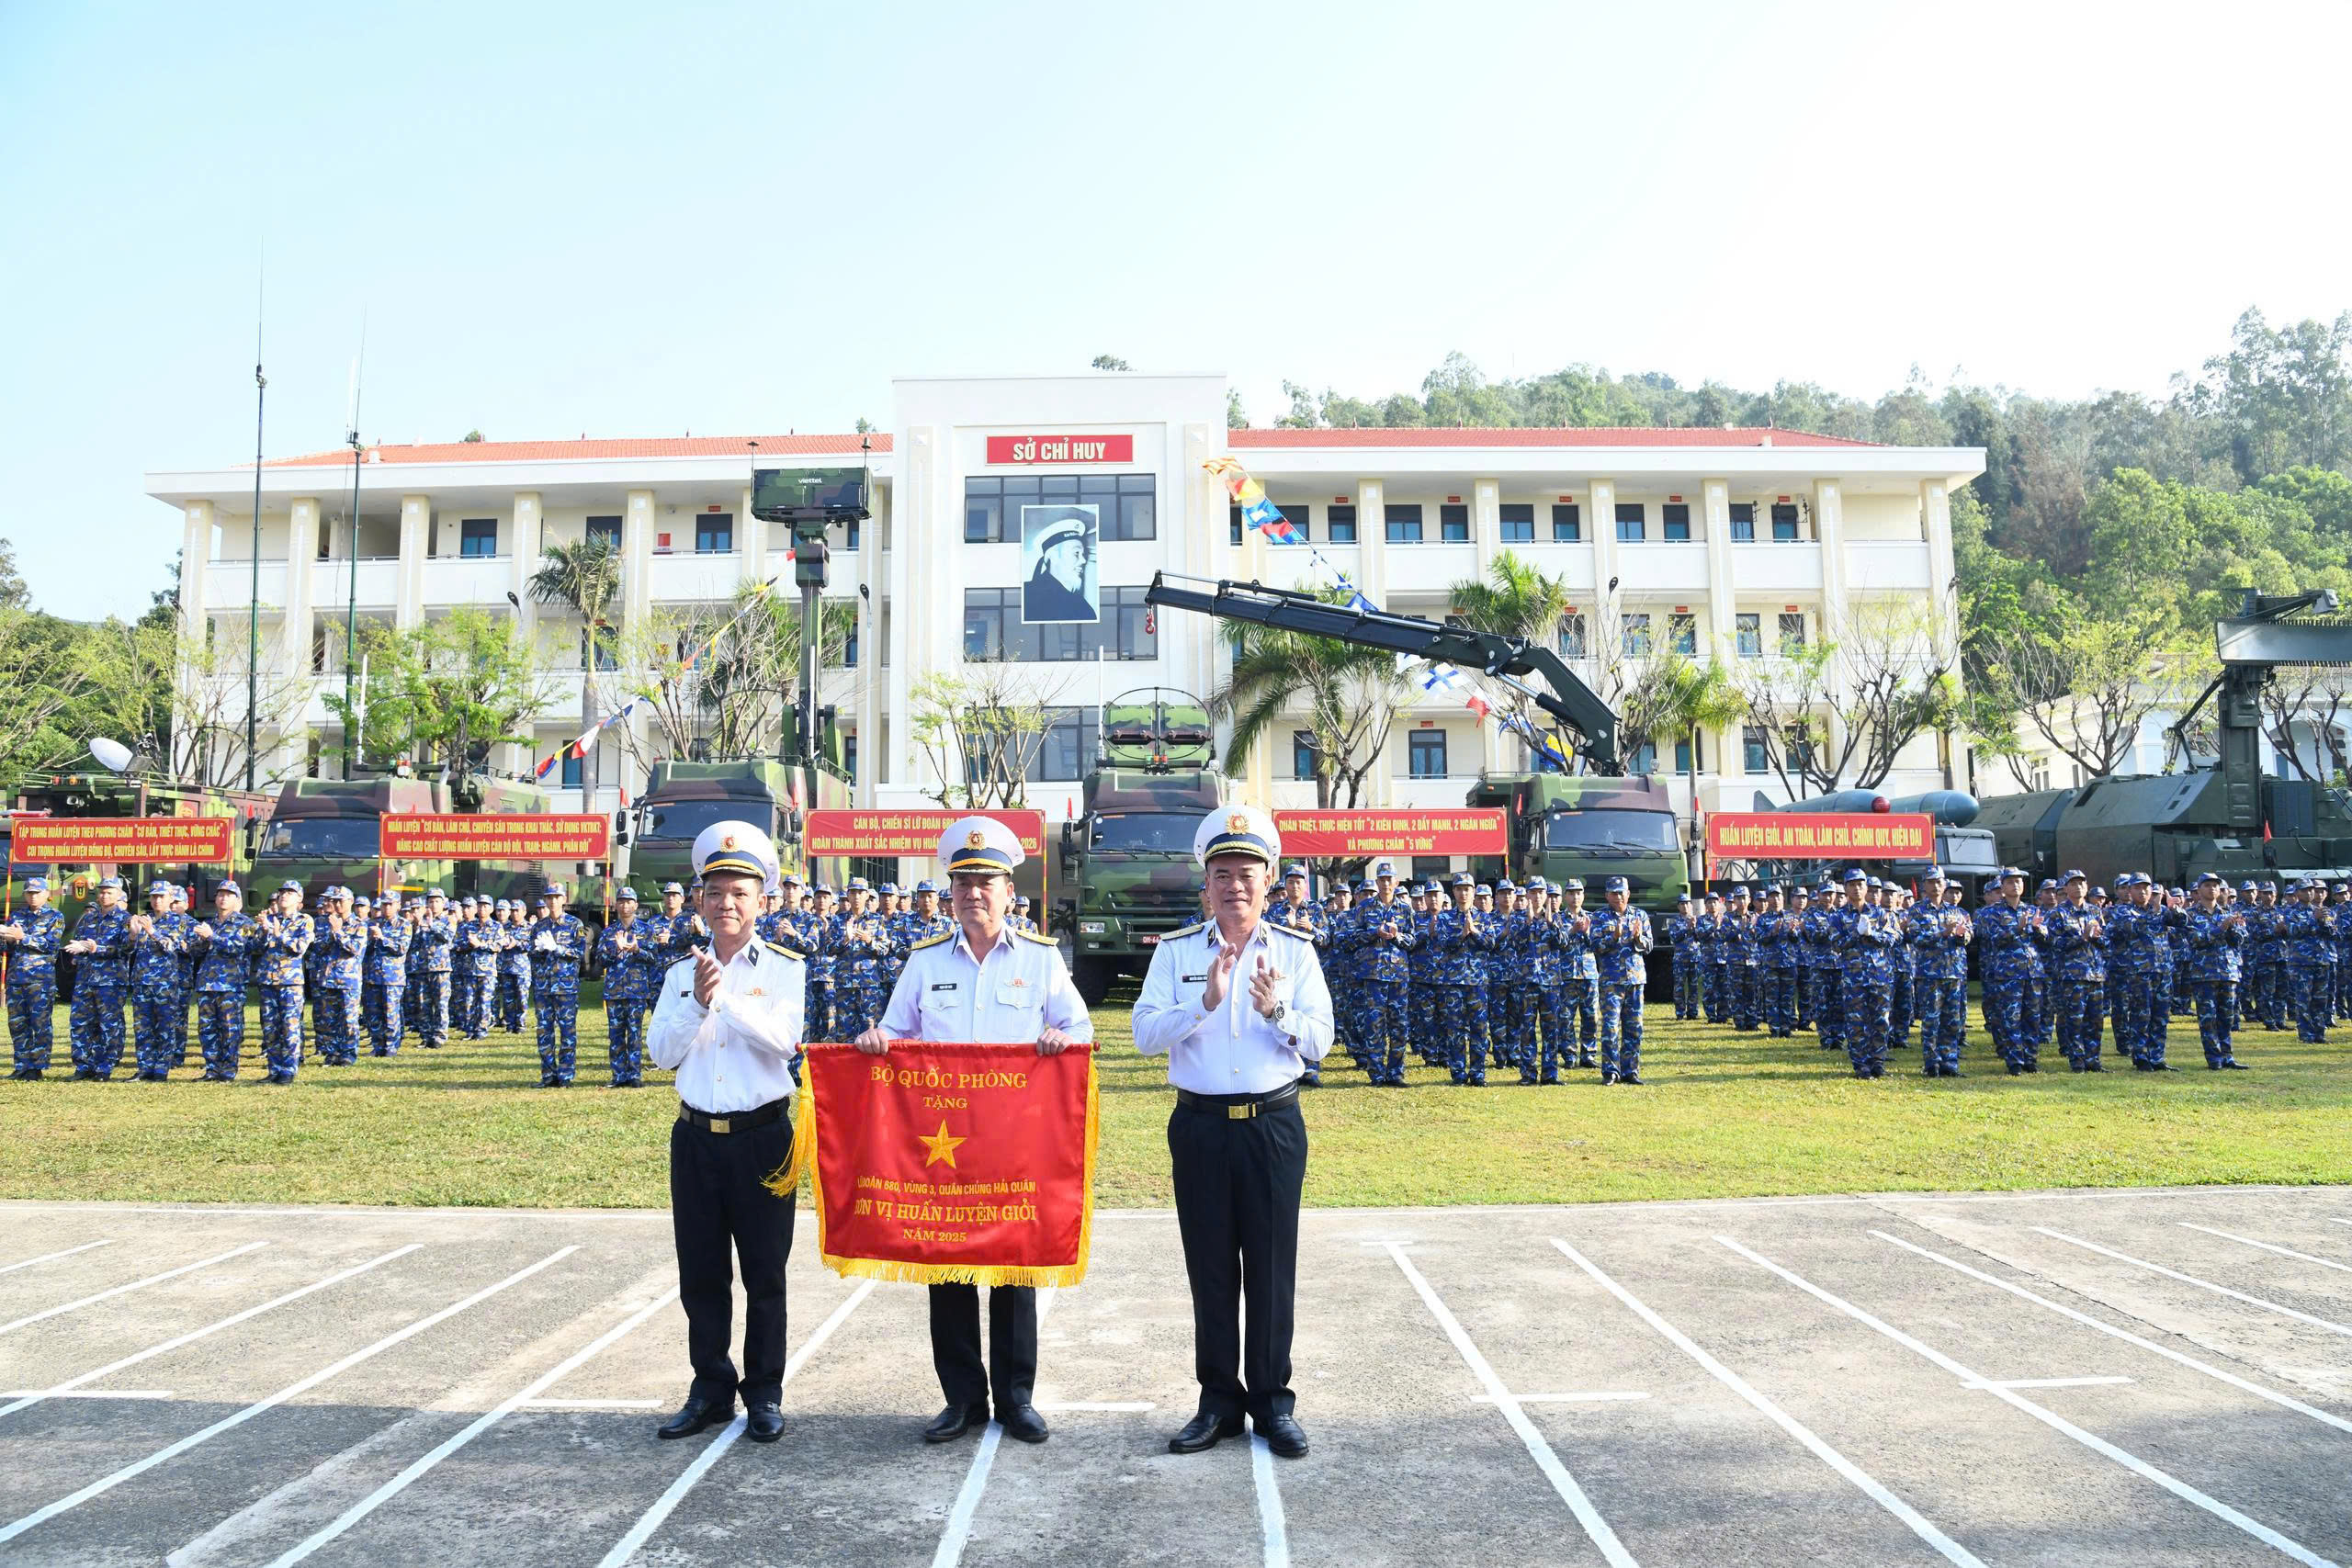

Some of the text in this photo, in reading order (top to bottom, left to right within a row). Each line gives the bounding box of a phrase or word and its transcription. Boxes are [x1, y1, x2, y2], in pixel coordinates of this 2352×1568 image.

[1013, 436, 1106, 461] SỞ CHỈ HUY
[853, 816, 867, 829] CÁN
[869, 816, 880, 832] BỘ,
[882, 814, 902, 829] CHIẾN
[904, 816, 911, 829] SĨ
[912, 816, 921, 829] LỮ
[922, 816, 941, 829] ĐOÀN
[1279, 818, 1297, 832] QUÁN
[1299, 818, 1317, 834] TRIỆT,
[1319, 818, 1336, 834] THỰC
[1337, 818, 1352, 834] HIỆN
[1354, 816, 1365, 831] TỐT
[1375, 818, 1391, 831] KIÊN
[1393, 818, 1410, 834] ĐỊNH,
[1411, 819, 1417, 830] 2
[1431, 818, 1453, 834] MẠNH,
[1454, 819, 1459, 830] 2
[1460, 818, 1478, 830] NGĂN
[812, 835, 831, 849] HOÀN
[832, 835, 854, 849] THÀNH
[855, 834, 873, 849] XUẤT
[874, 833, 888, 849] SẮC
[889, 835, 911, 852] NHIỆM
[913, 838, 922, 852] VỤ
[1021, 838, 1037, 849] 2026
[1347, 837, 1356, 851] VÀ
[1357, 838, 1384, 851] PHƯƠNG
[1385, 836, 1404, 851] CHÂM
[1720, 820, 1922, 851] HUẤN LUYỆN GIỎI, AN TOÀN, LÀM CHỦ, CHÍNH QUY, HIỆN ĐẠI
[870, 1064, 1028, 1089] BỘ QUỐC PHÒNG
[922, 1095, 968, 1110] TẶNG
[884, 1179, 900, 1194] 680,
[904, 1179, 928, 1194] VÙNG
[930, 1185, 937, 1197] 3,
[939, 1182, 963, 1195] QUÂN
[964, 1179, 992, 1195] CHỦNG
[994, 1178, 1009, 1194] HẢI
[1011, 1179, 1036, 1192] QUÂN
[876, 1200, 893, 1222] VỊ
[897, 1198, 943, 1222] HUẤN
[944, 1201, 999, 1226] LUYỆN
[1001, 1198, 1036, 1221] GIỎI
[902, 1227, 967, 1243] NĂM 2025
